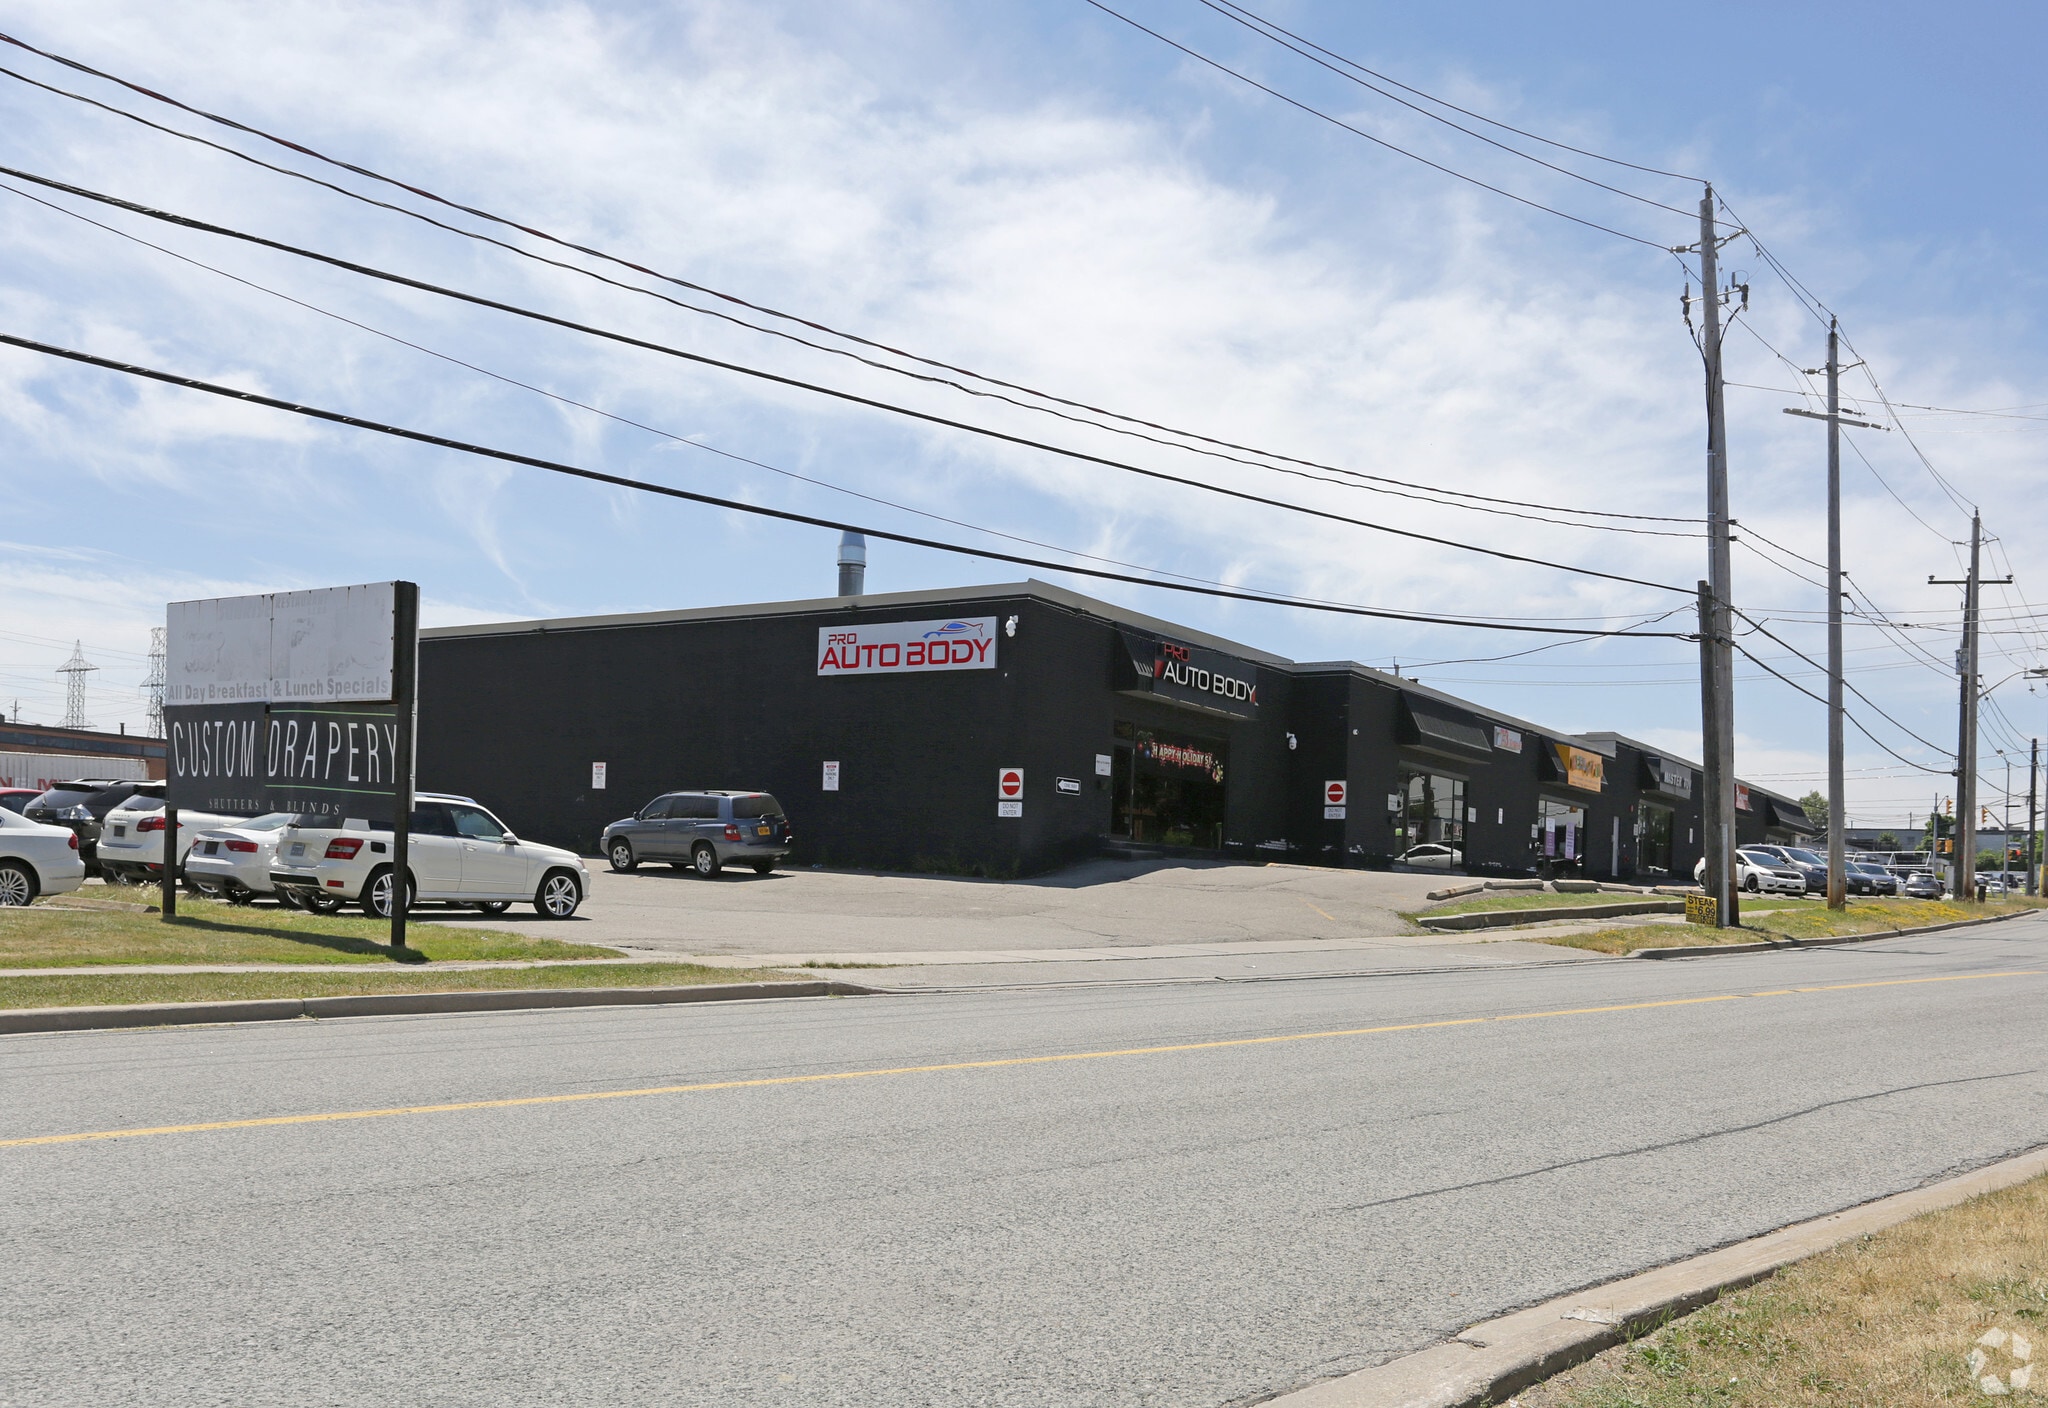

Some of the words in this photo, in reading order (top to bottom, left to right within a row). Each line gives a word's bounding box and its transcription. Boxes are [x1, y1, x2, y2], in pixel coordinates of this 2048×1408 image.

[828, 633, 857, 645] PRO
[819, 643, 900, 670] AUTO
[906, 638, 993, 666] BODY
[1163, 642, 1191, 662] PRO
[168, 685, 182, 699] All
[185, 685, 206, 703] Day
[208, 682, 267, 699] Breakfast
[273, 682, 282, 697] &
[286, 678, 323, 697] Lunch
[327, 676, 389, 699] Specials
[1163, 661, 1210, 691] AUTO
[1213, 674, 1256, 703] BODY
[173, 720, 255, 777] CUSTOM
[267, 720, 397, 784] DRAPERY
[208, 798, 259, 810] SHUTTERS
[270, 799, 275, 811] &
[286, 800, 340, 815] BLINDS
[1688, 895, 1715, 908] STEAK
